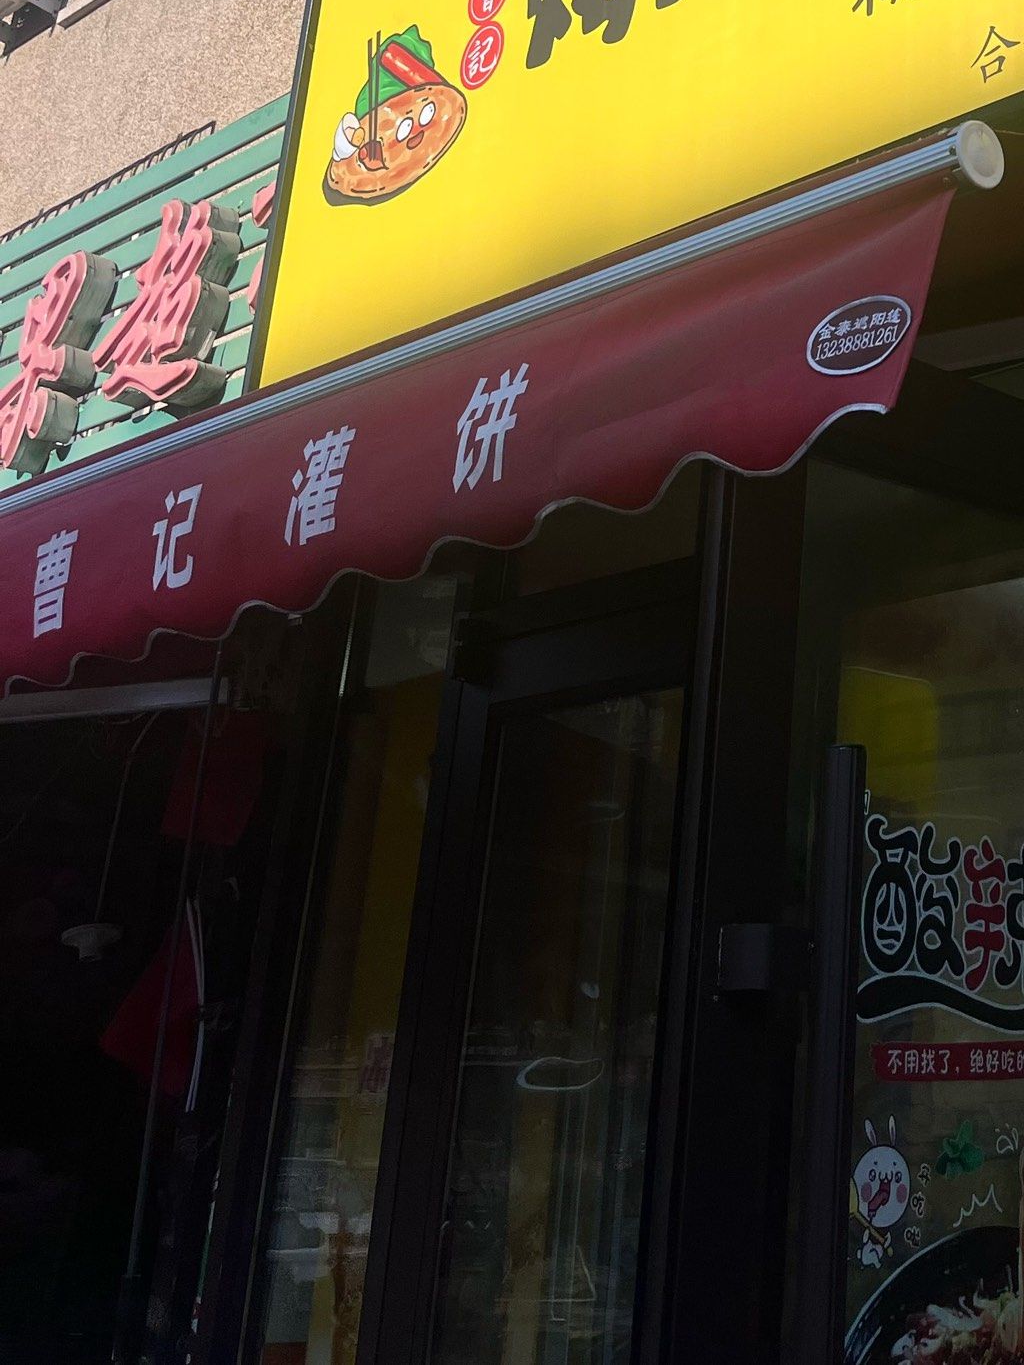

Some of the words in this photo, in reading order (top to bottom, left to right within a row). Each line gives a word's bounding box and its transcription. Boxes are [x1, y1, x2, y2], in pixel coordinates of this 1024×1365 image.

[815, 325, 898, 361] 13238881261
[33, 363, 530, 639] 曹记灌饼
